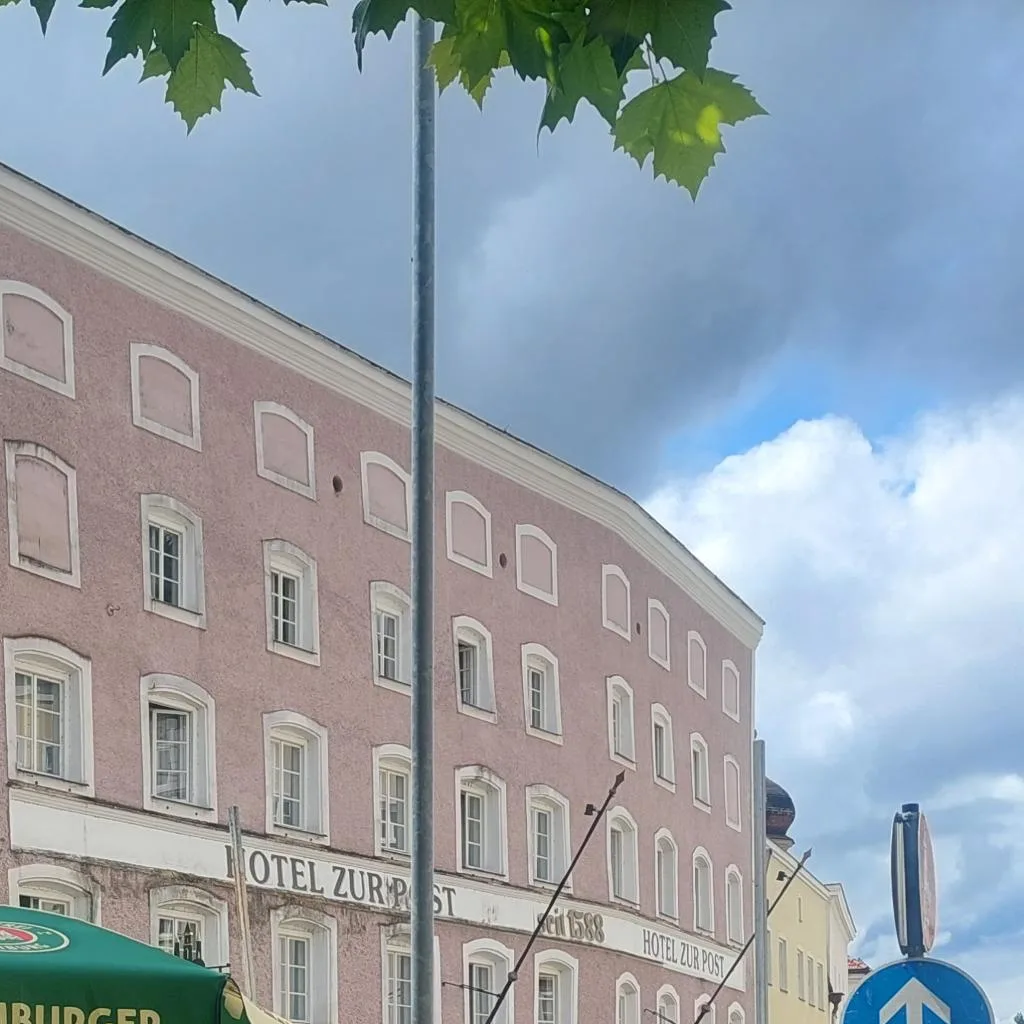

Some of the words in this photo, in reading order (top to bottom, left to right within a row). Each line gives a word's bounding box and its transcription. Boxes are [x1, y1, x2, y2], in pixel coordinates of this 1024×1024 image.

[332, 865, 385, 904] ZUR
[392, 877, 456, 915] PST
[567, 908, 605, 943] 1588
[642, 929, 677, 963] HOTEL
[681, 942, 700, 970] ZUR
[701, 949, 725, 978] POST
